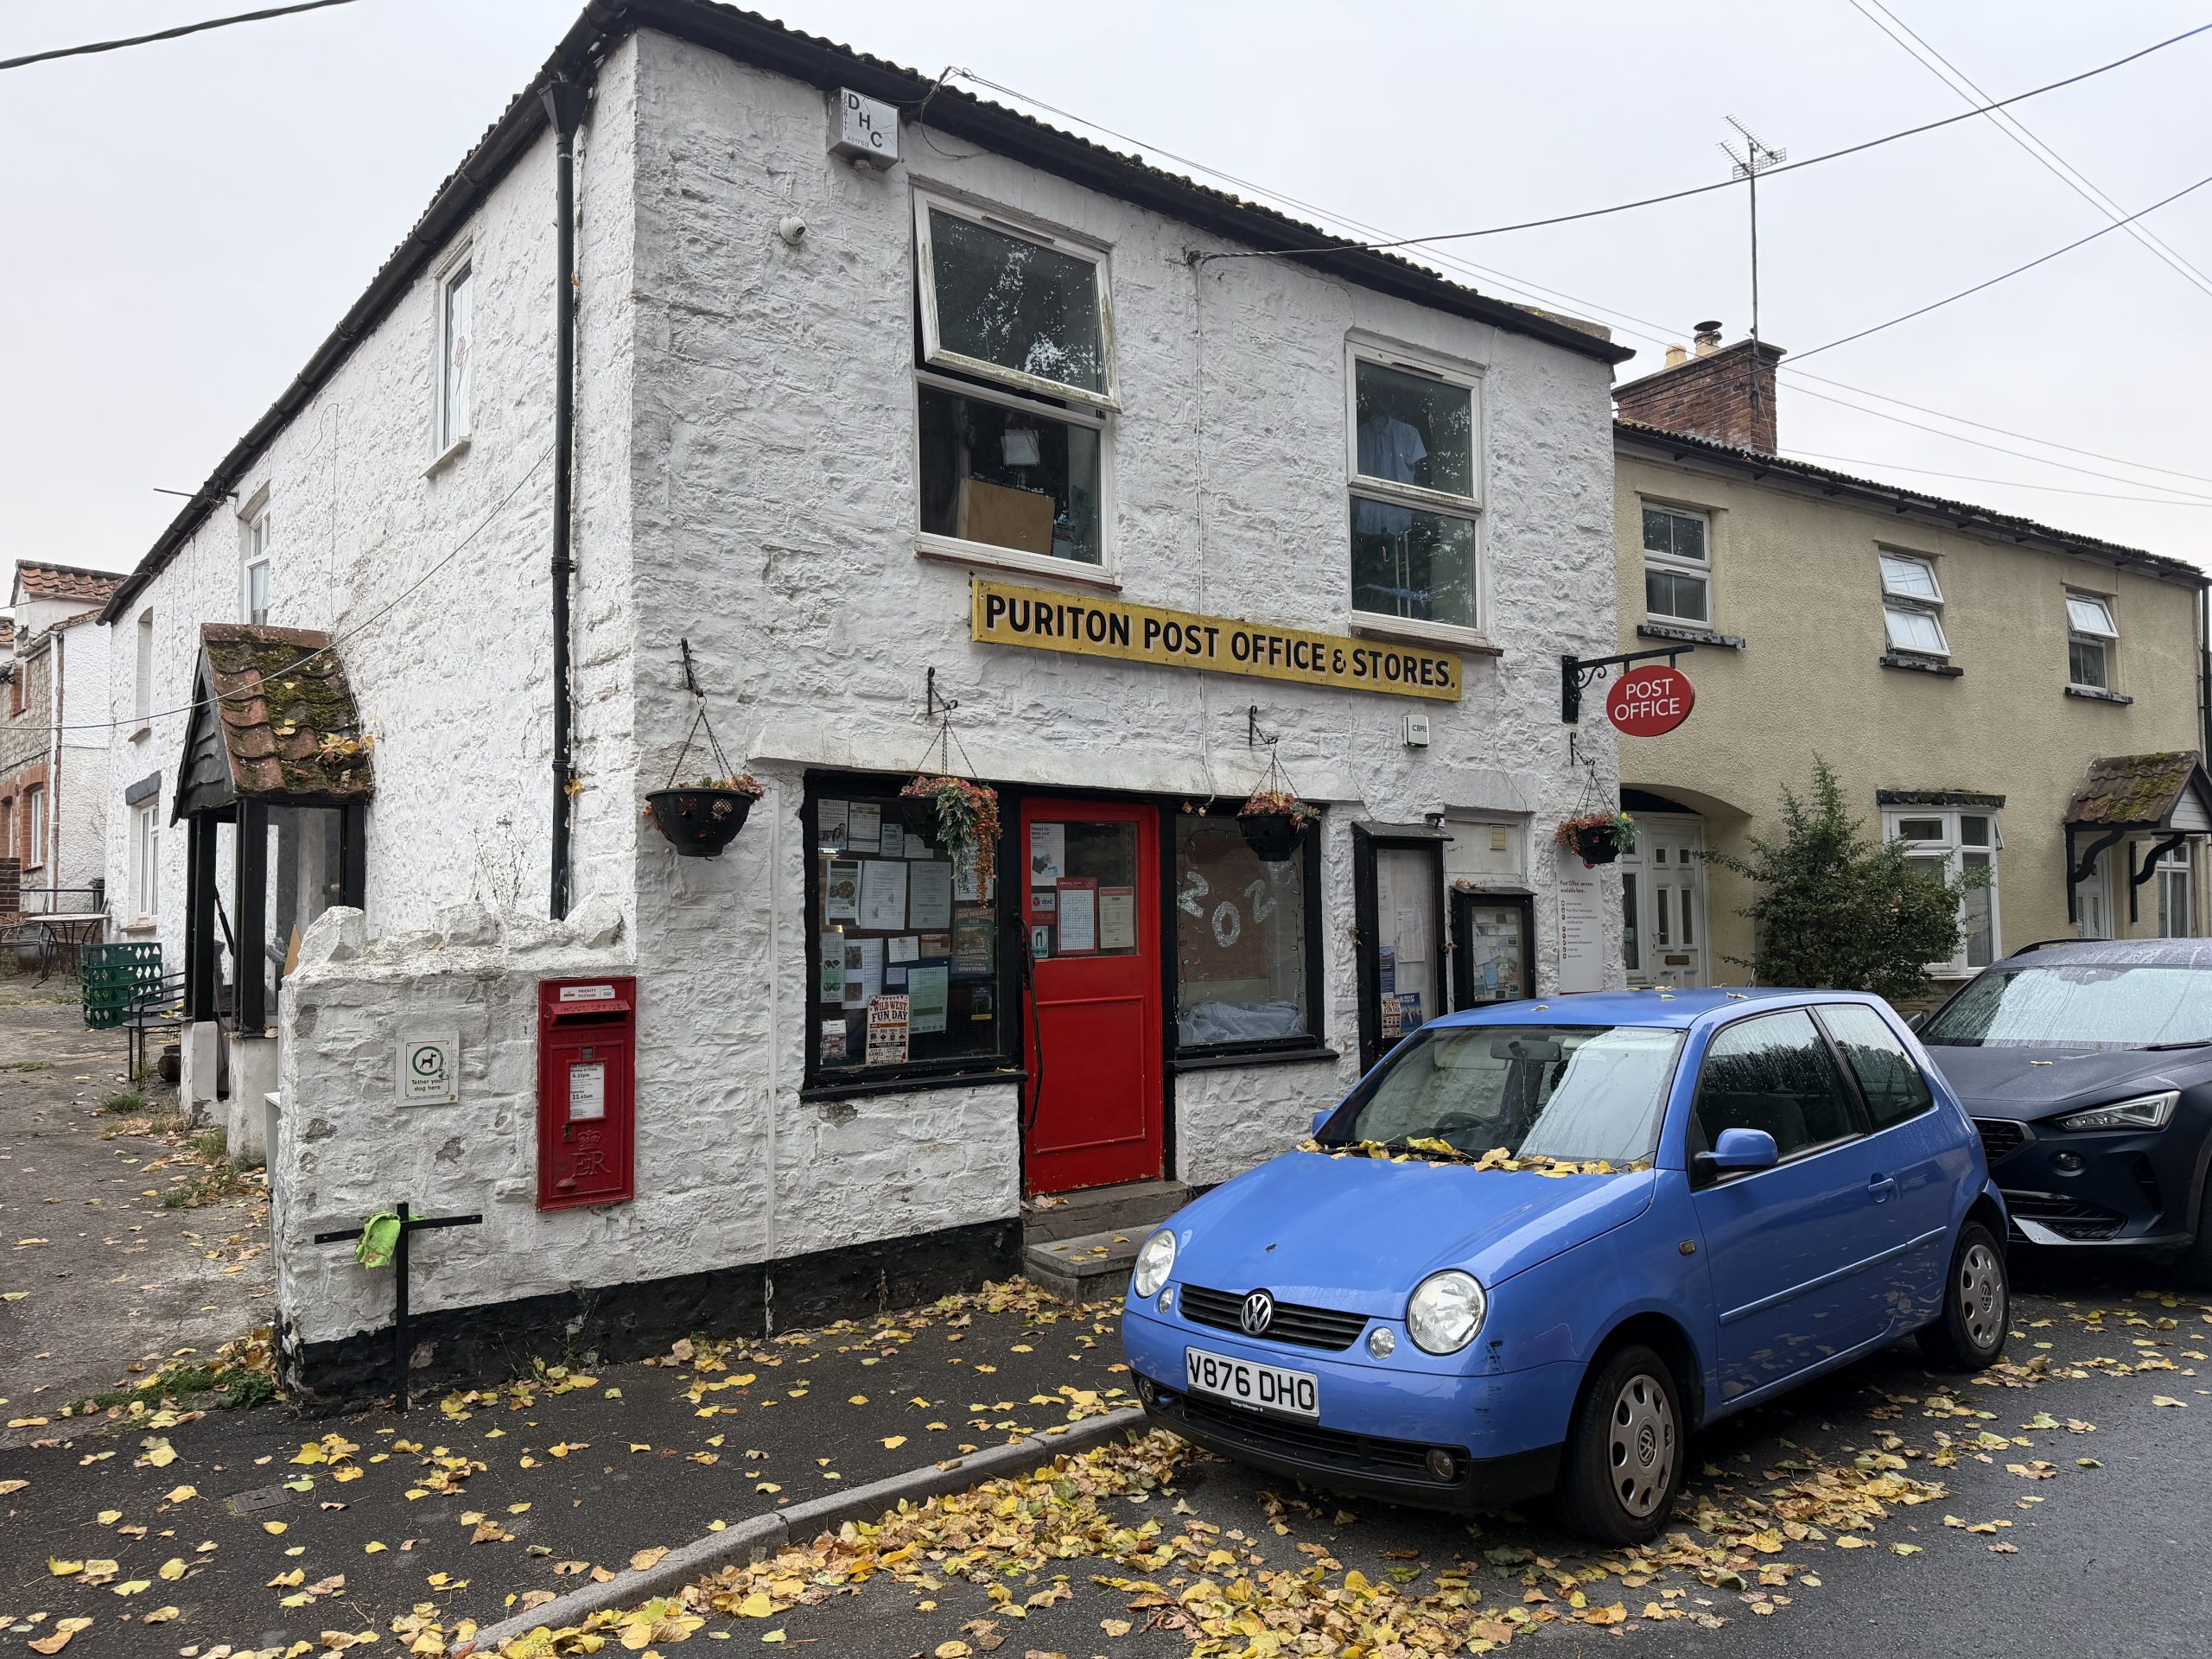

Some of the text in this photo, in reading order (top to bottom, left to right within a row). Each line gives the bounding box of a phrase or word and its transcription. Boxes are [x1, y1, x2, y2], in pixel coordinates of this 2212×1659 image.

[986, 594, 1455, 690] PURITON POST OFFICE & STORES.
[1625, 677, 1674, 701] POST
[1614, 698, 1681, 722] OFFICE
[1041, 897, 1052, 906] dpd
[872, 1010, 907, 1022] FUN DAY
[874, 1001, 907, 1012] WILD WEST
[1188, 1353, 1315, 1410] V876 DHO
